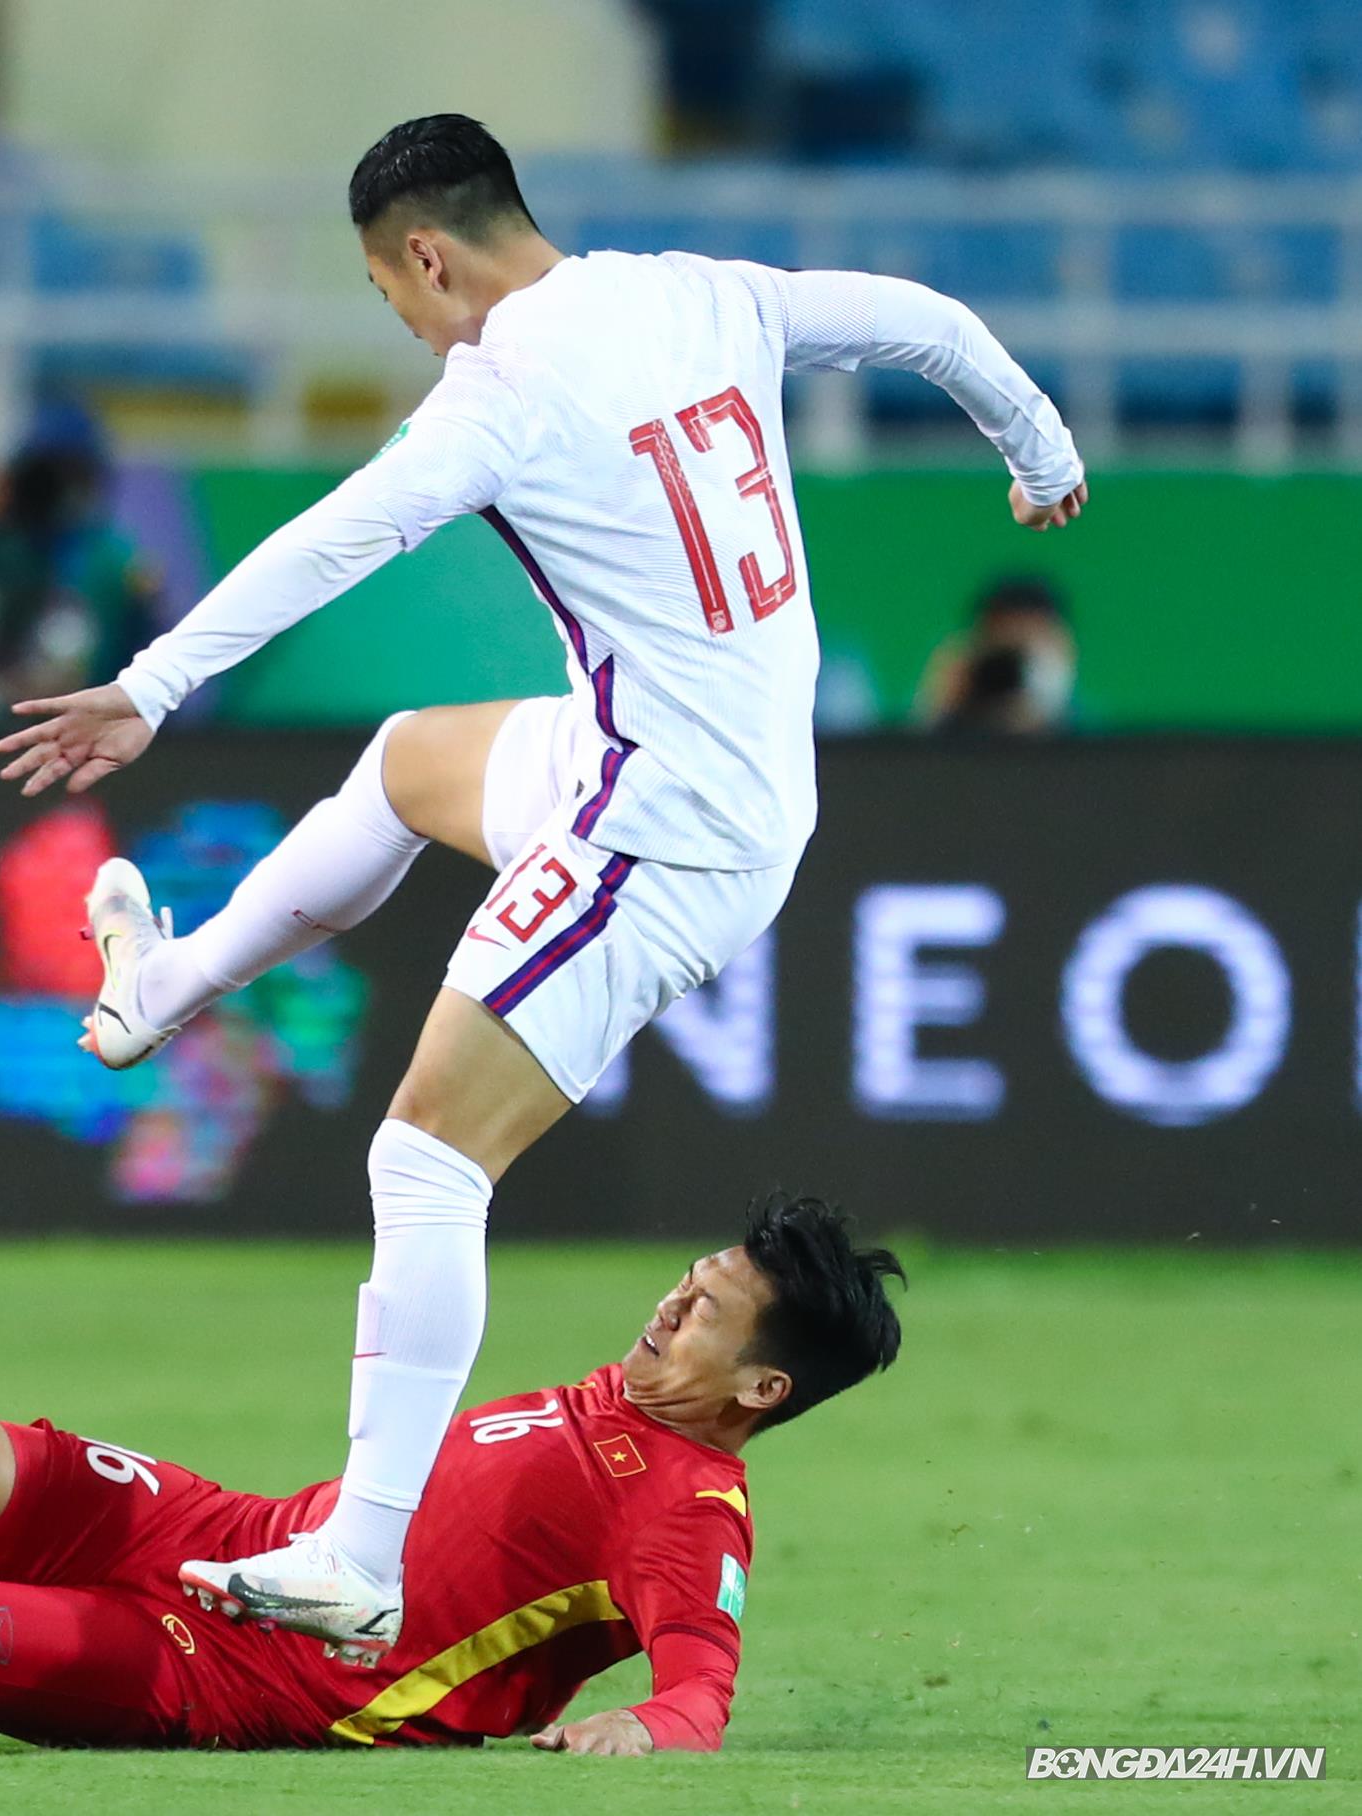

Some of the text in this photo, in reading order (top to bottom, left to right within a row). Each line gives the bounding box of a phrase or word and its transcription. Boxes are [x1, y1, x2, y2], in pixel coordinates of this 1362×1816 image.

[629, 385, 796, 636] 13
[485, 843, 578, 943] 13
[583, 883, 1362, 1125] NEO
[469, 1399, 564, 1445] 16
